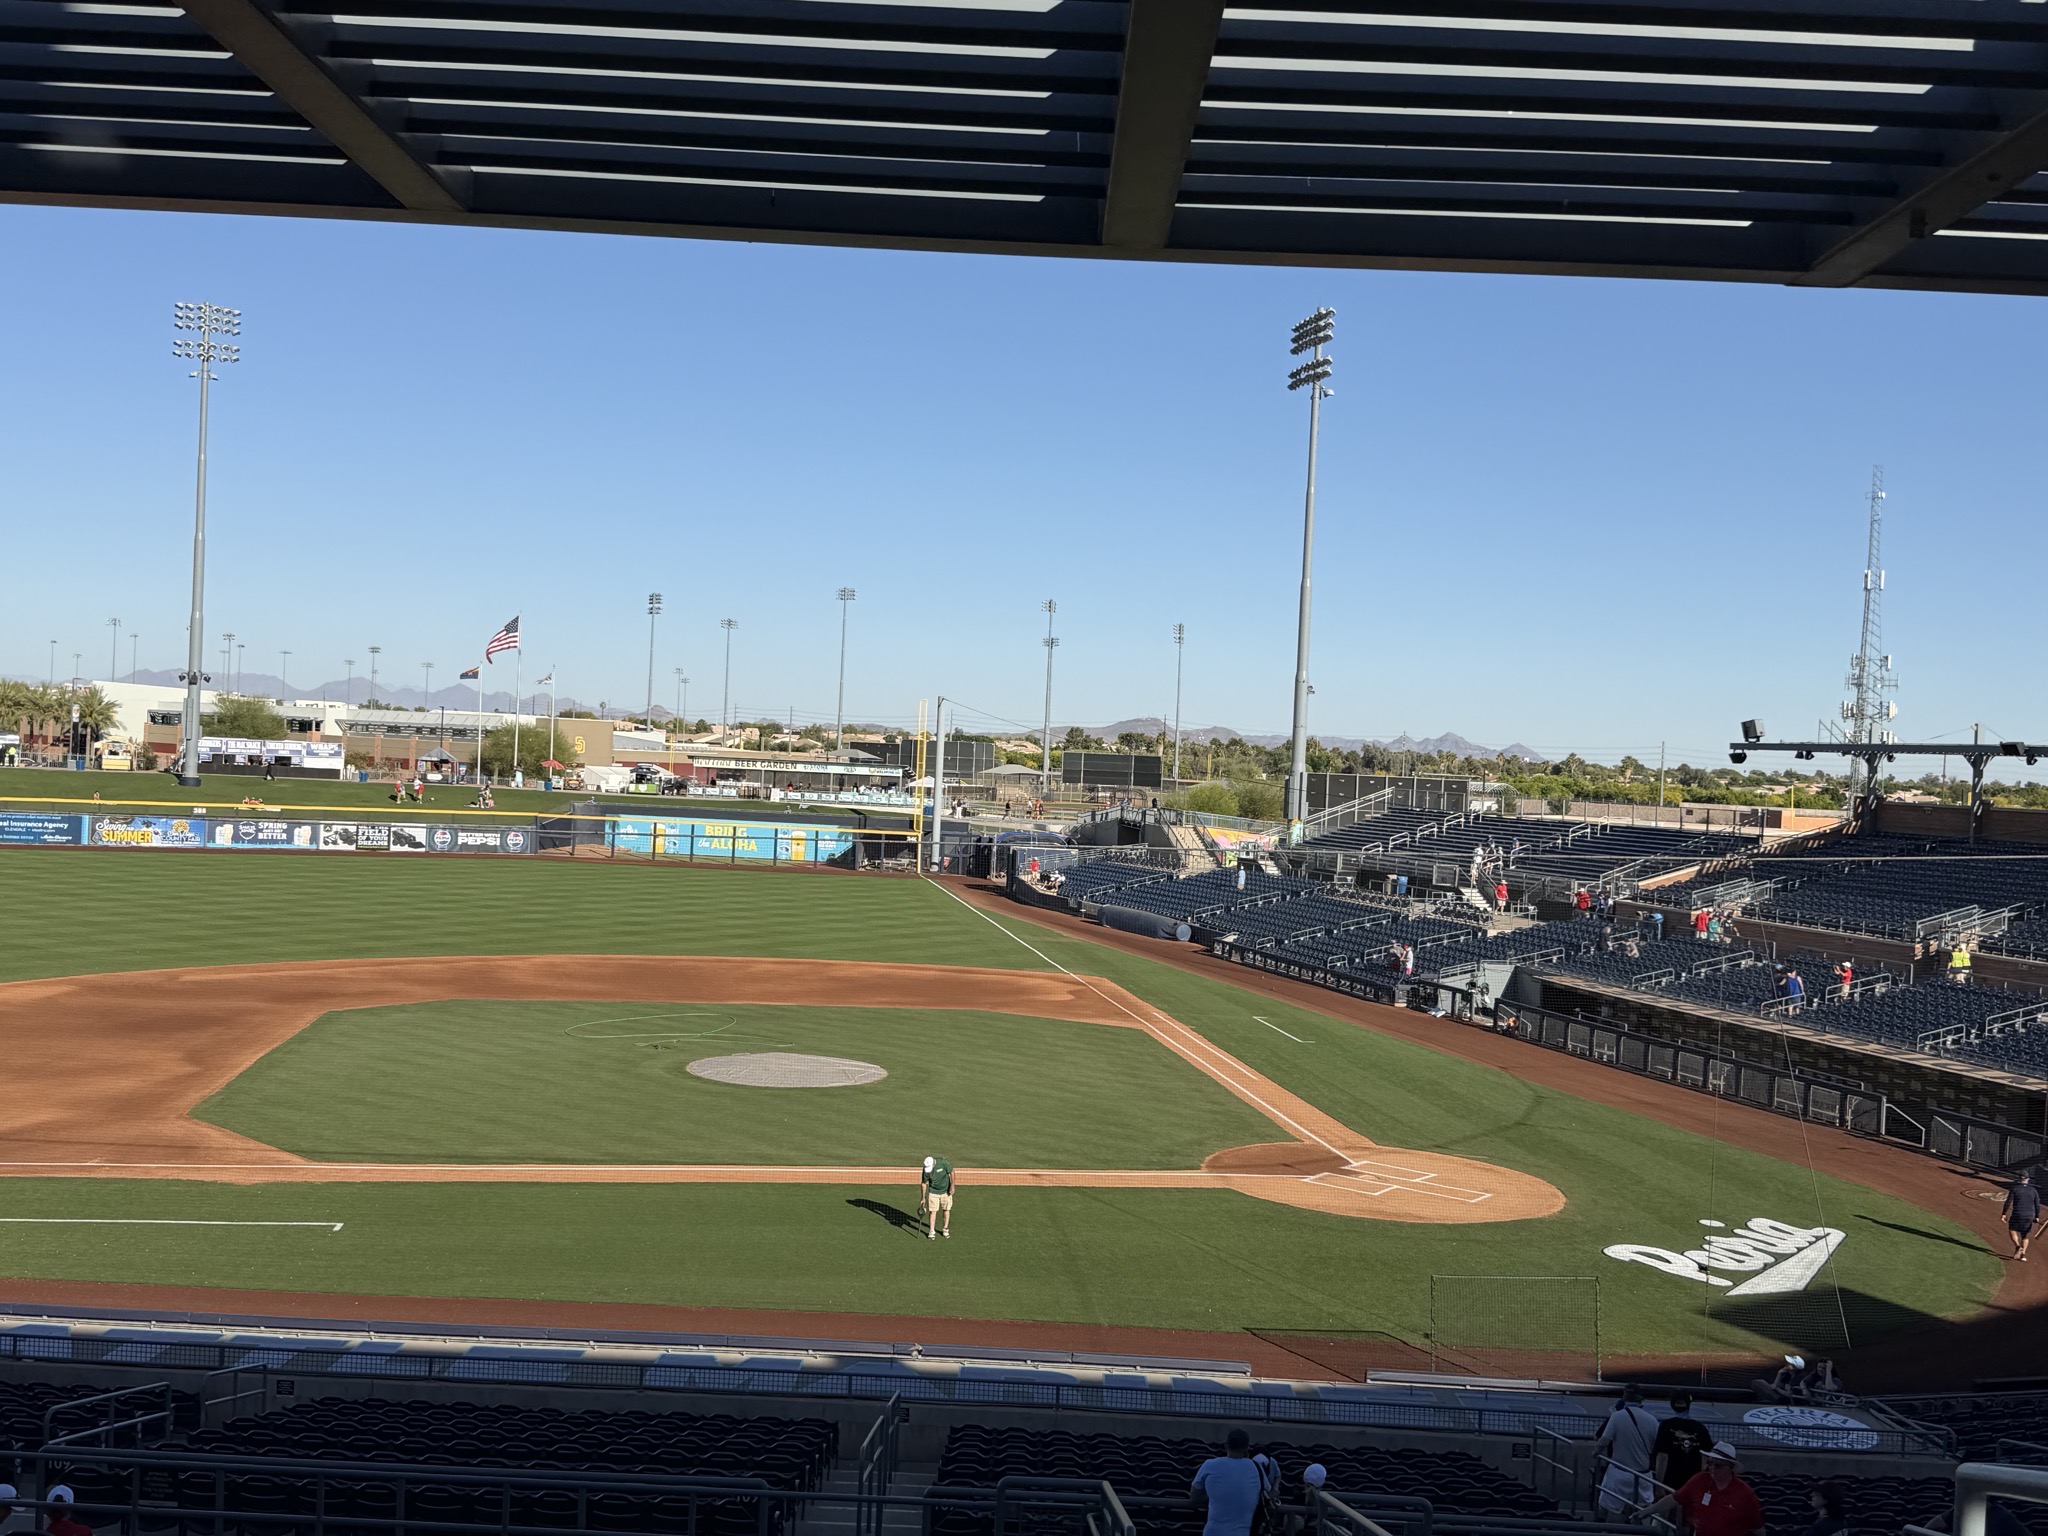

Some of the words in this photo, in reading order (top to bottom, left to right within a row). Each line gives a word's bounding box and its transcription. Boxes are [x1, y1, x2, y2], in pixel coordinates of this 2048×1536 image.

[760, 761, 797, 770] GARDEN
[43, 821, 69, 830] Agency
[96, 819, 127, 834] Swing
[705, 825, 748, 838] BRING
[102, 831, 152, 843] SUMMER
[458, 837, 500, 846] PEPSI
[711, 838, 758, 851] ALOHA
[1749, 1406, 1849, 1425] PEORIA
